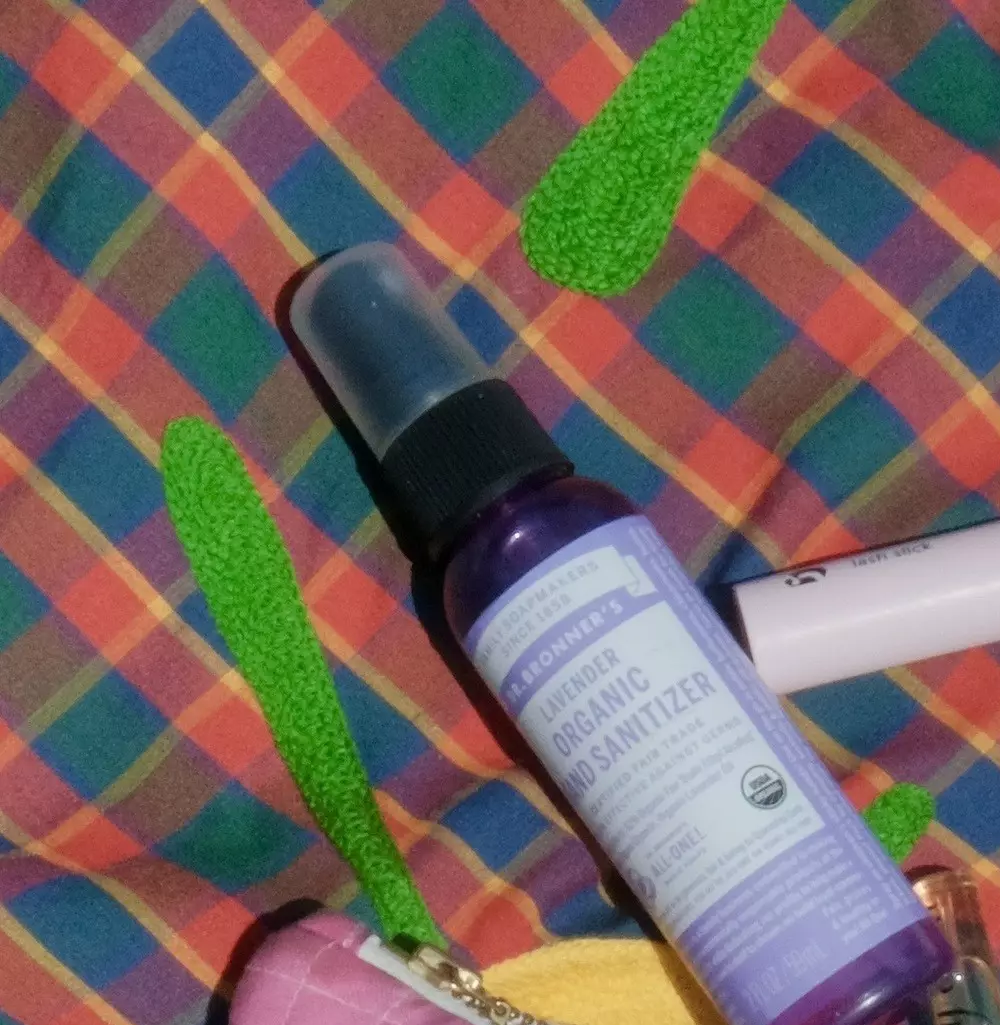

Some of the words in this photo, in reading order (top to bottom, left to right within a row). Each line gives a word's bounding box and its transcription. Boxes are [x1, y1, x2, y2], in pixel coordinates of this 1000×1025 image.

[501, 558, 599, 631] SOAPMAKERS
[500, 620, 536, 657] SINCE
[520, 597, 624, 684] BRONNER'S
[538, 645, 621, 724] LAVENDER
[550, 663, 652, 757] ORGANIC
[590, 668, 716, 774] SANITIZER
[660, 716, 705, 749] TRADE
